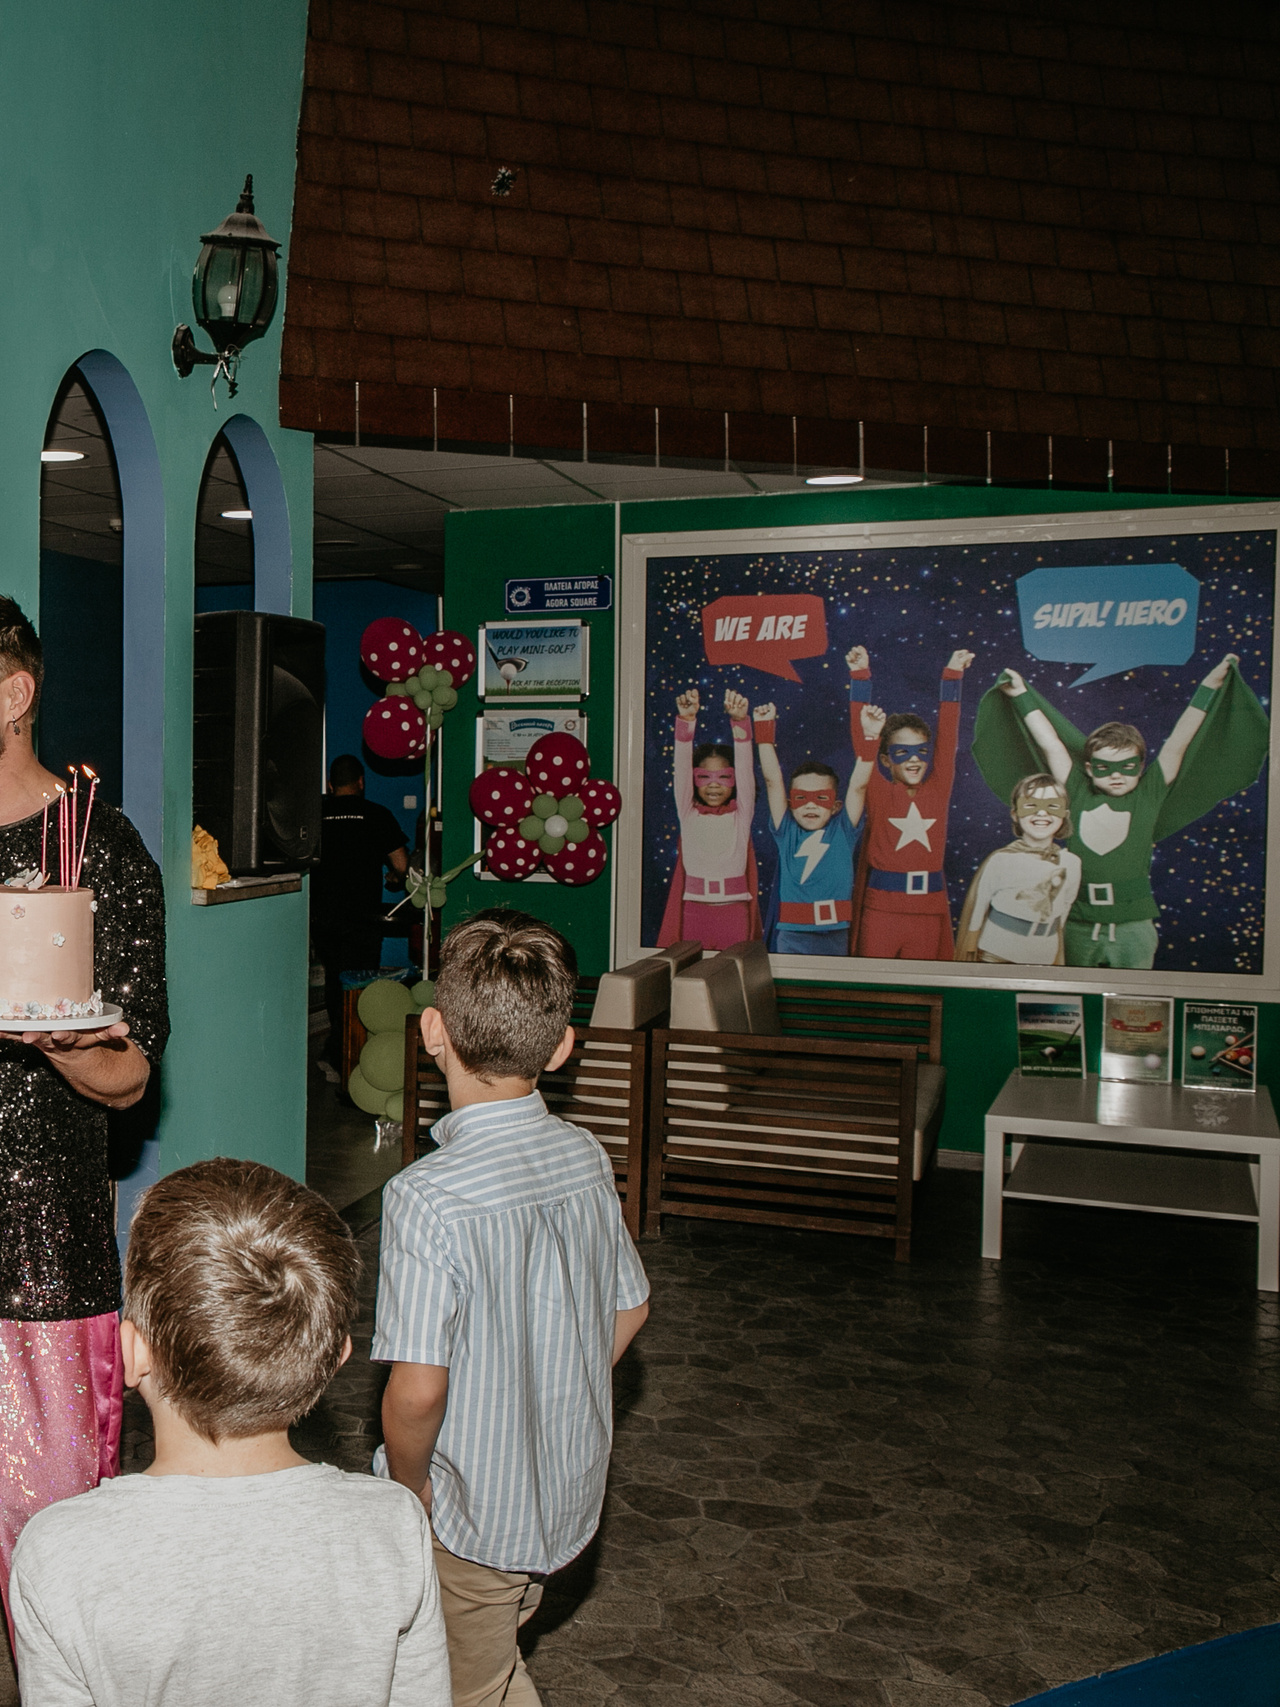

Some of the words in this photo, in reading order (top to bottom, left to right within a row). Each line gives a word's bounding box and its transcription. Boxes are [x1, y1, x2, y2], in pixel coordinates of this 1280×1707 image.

[544, 581, 572, 591] ΠΛΑΤΕΙΑ
[573, 580, 599, 590] ΑΓΟΡΑΣ
[545, 598, 569, 608] AGORA
[570, 597, 598, 607] SQUARE
[1033, 600, 1114, 630] SUPA!
[1114, 598, 1188, 627] HERO
[492, 629, 524, 640] WOULD
[524, 629, 544, 640] YOU
[544, 628, 567, 639] LIKE
[714, 616, 752, 642] WE
[756, 614, 808, 642] ARE
[497, 646, 519, 656] PLAY
[520, 643, 576, 655] MINI-GOLF?
[533, 679, 545, 687] THE
